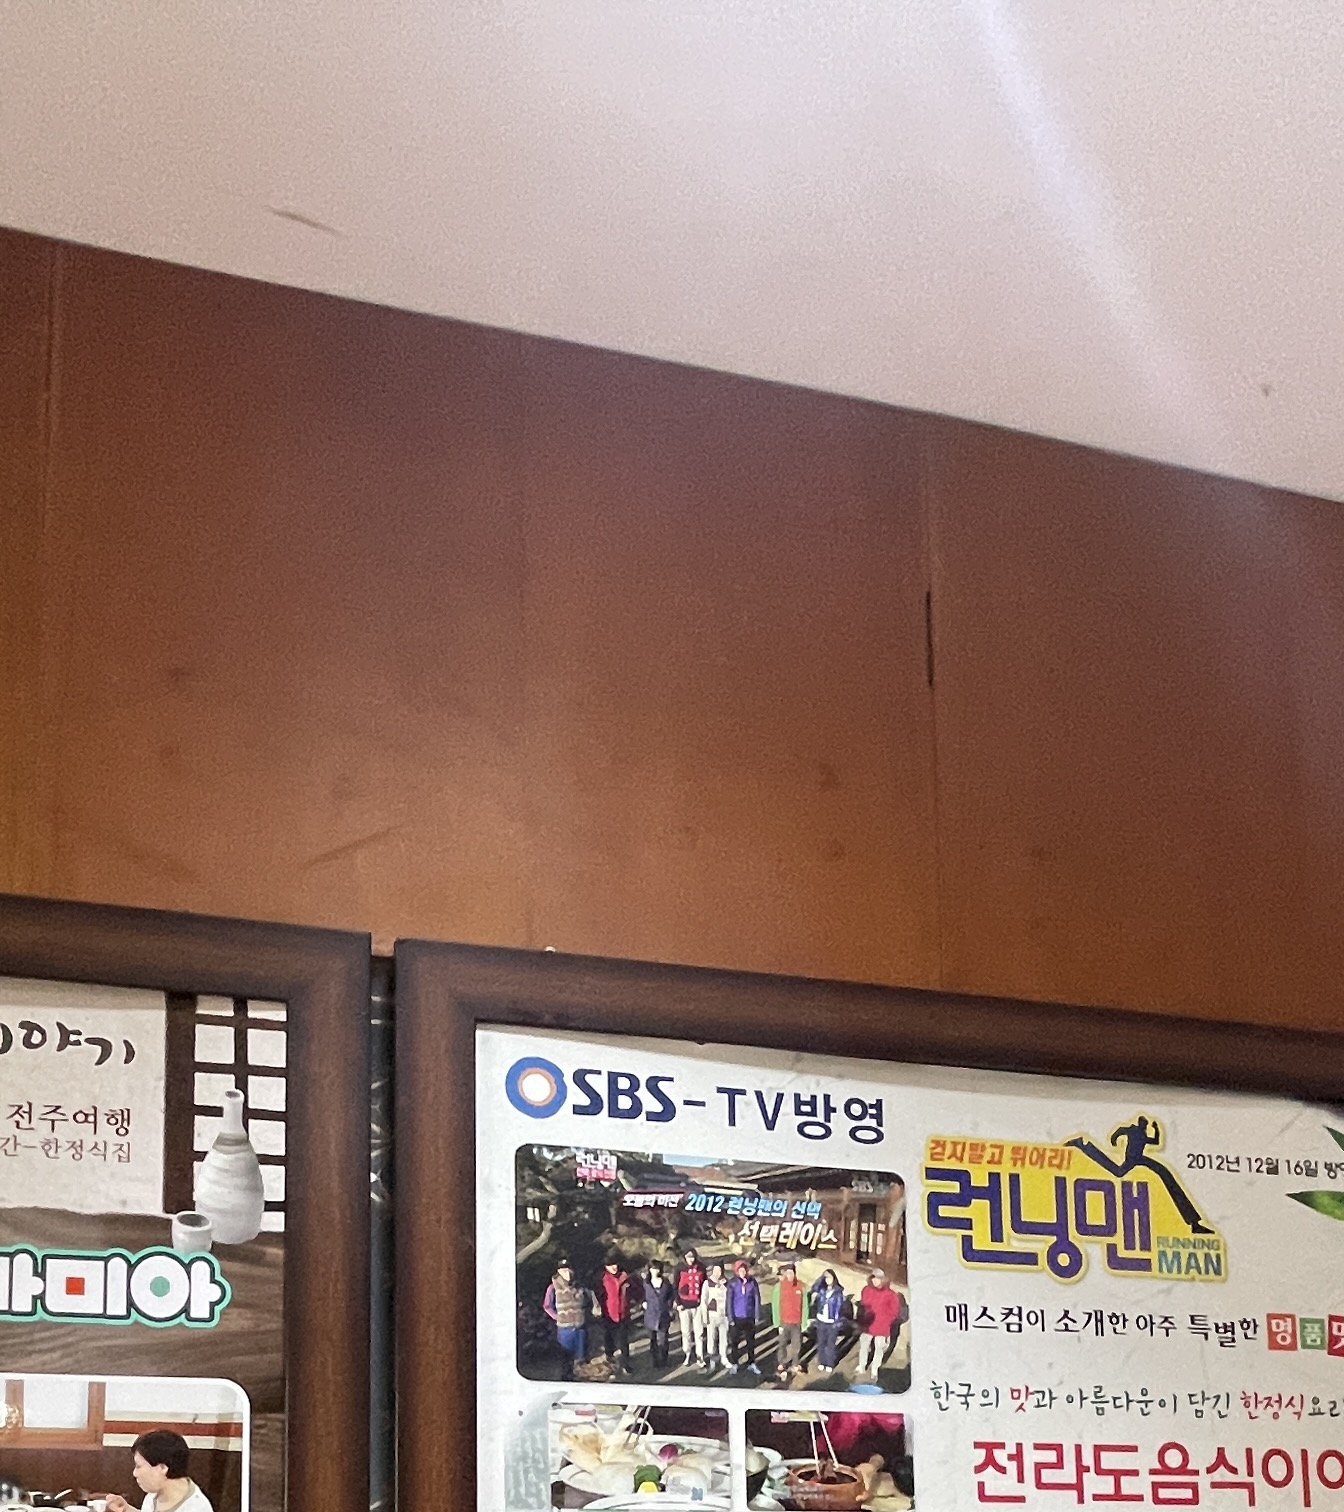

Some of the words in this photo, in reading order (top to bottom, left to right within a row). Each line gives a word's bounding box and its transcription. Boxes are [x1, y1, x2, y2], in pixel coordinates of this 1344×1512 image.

[6, 1101, 132, 1138] 전주여행
[929, 1139, 1005, 1164] 걷지말고
[1010, 1145, 1072, 1170] 뛰어라!
[1187, 1153, 1240, 1173] 2012년
[1245, 1157, 1280, 1176] 12월
[1285, 1159, 1318, 1178] 16일
[685, 1194, 722, 1213] 2012
[923, 1166, 1152, 1279] 런닝맨
[1157, 1235, 1221, 1251] RUNNING
[1157, 1251, 1223, 1277] MAN
[945, 1302, 1046, 1334] 매스컴이
[1053, 1309, 1129, 1337] 소개한
[1134, 1314, 1178, 1338] 아주
[1186, 1314, 1260, 1348] 특별한
[930, 1381, 999, 1412] 한국의
[1009, 1384, 1057, 1413] 맛과
[1188, 1389, 1231, 1418] 담긴
